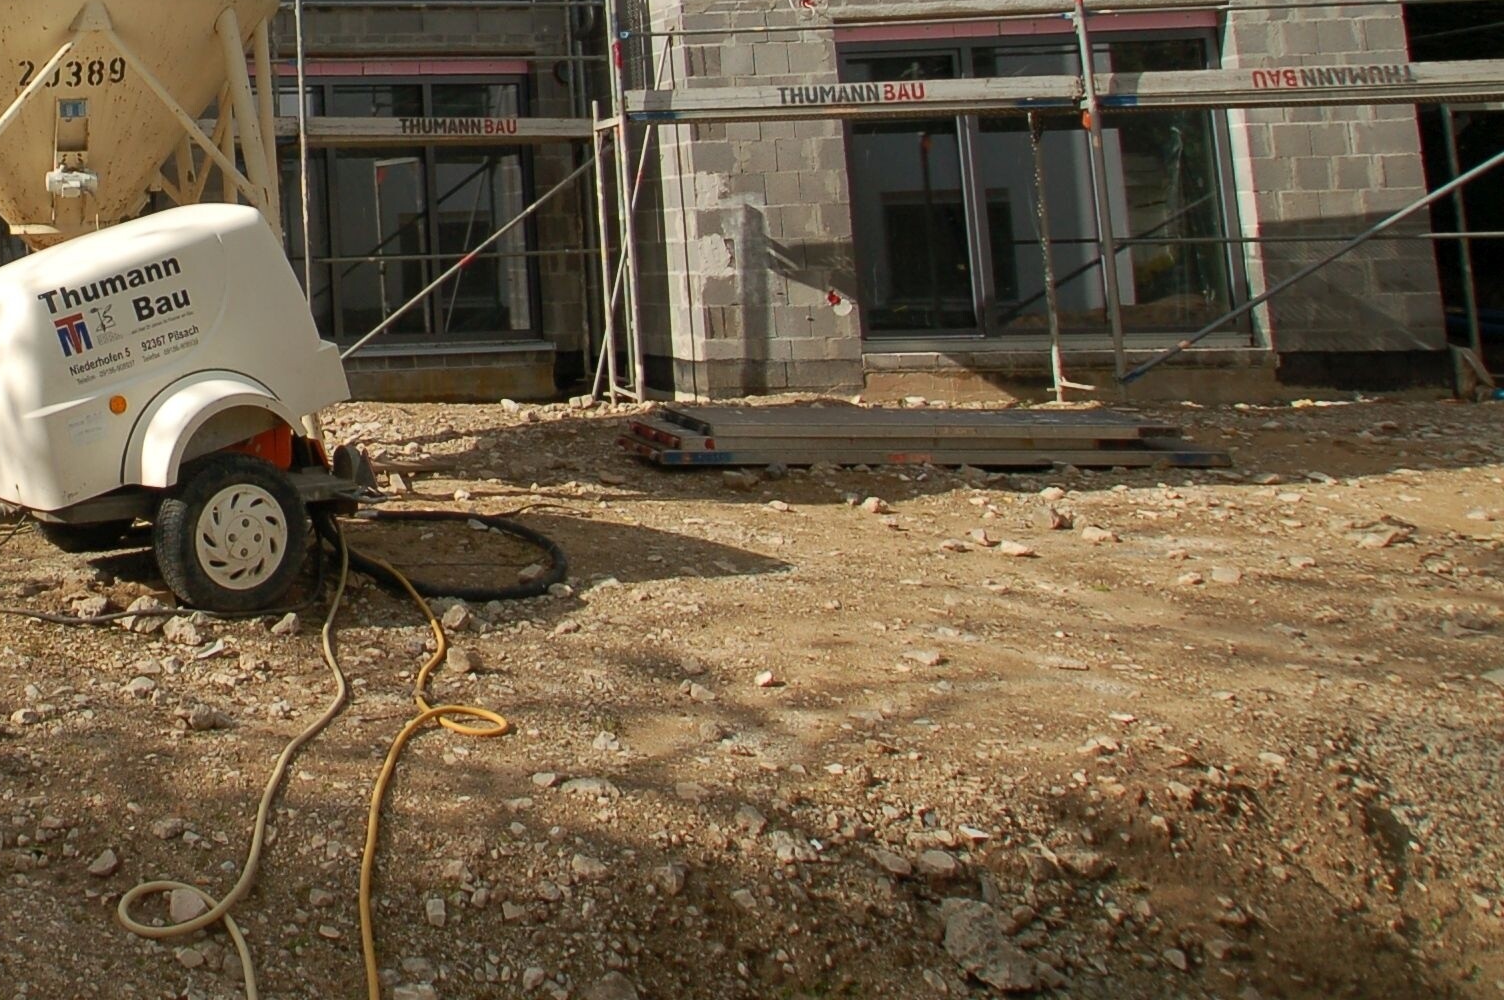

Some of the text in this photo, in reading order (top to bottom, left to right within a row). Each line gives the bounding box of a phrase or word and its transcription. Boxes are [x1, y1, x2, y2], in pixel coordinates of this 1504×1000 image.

[37, 257, 182, 314] Thumann
[132, 289, 191, 322] Bau
[69, 351, 124, 376] Niederhofen
[125, 347, 132, 358] 5
